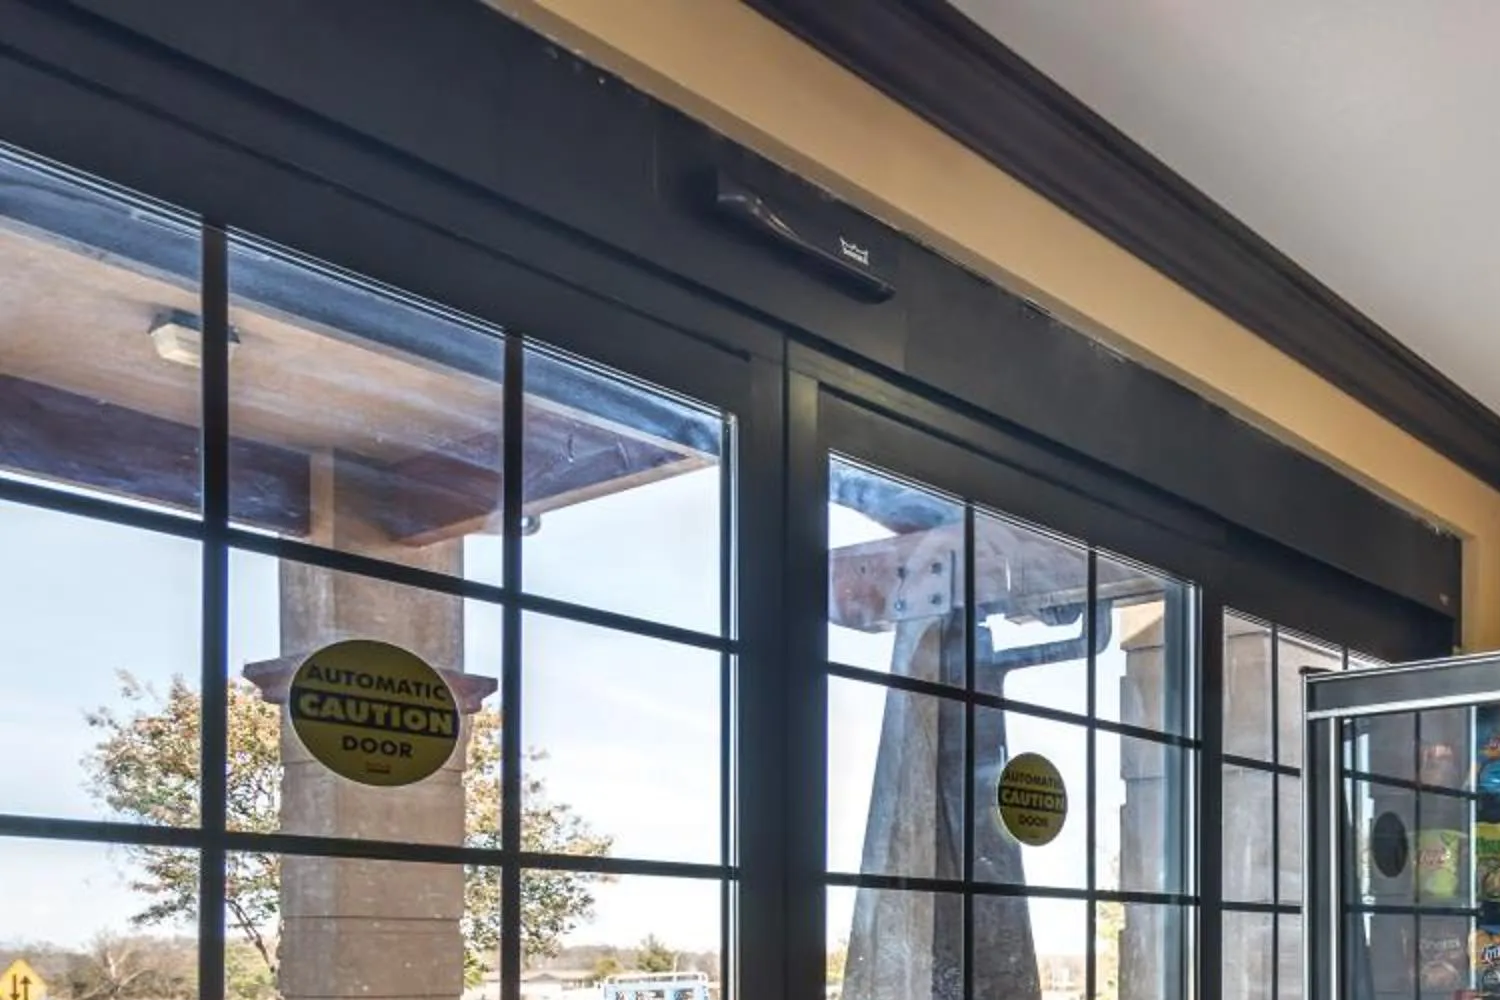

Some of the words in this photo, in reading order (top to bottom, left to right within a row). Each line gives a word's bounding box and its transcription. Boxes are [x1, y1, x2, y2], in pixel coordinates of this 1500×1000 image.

[307, 664, 447, 701] AUTOMATIC
[301, 693, 454, 735] CAUTION
[342, 735, 414, 758] DOOR
[1002, 788, 1064, 811] CAUTION
[1018, 814, 1049, 827] DOOR
